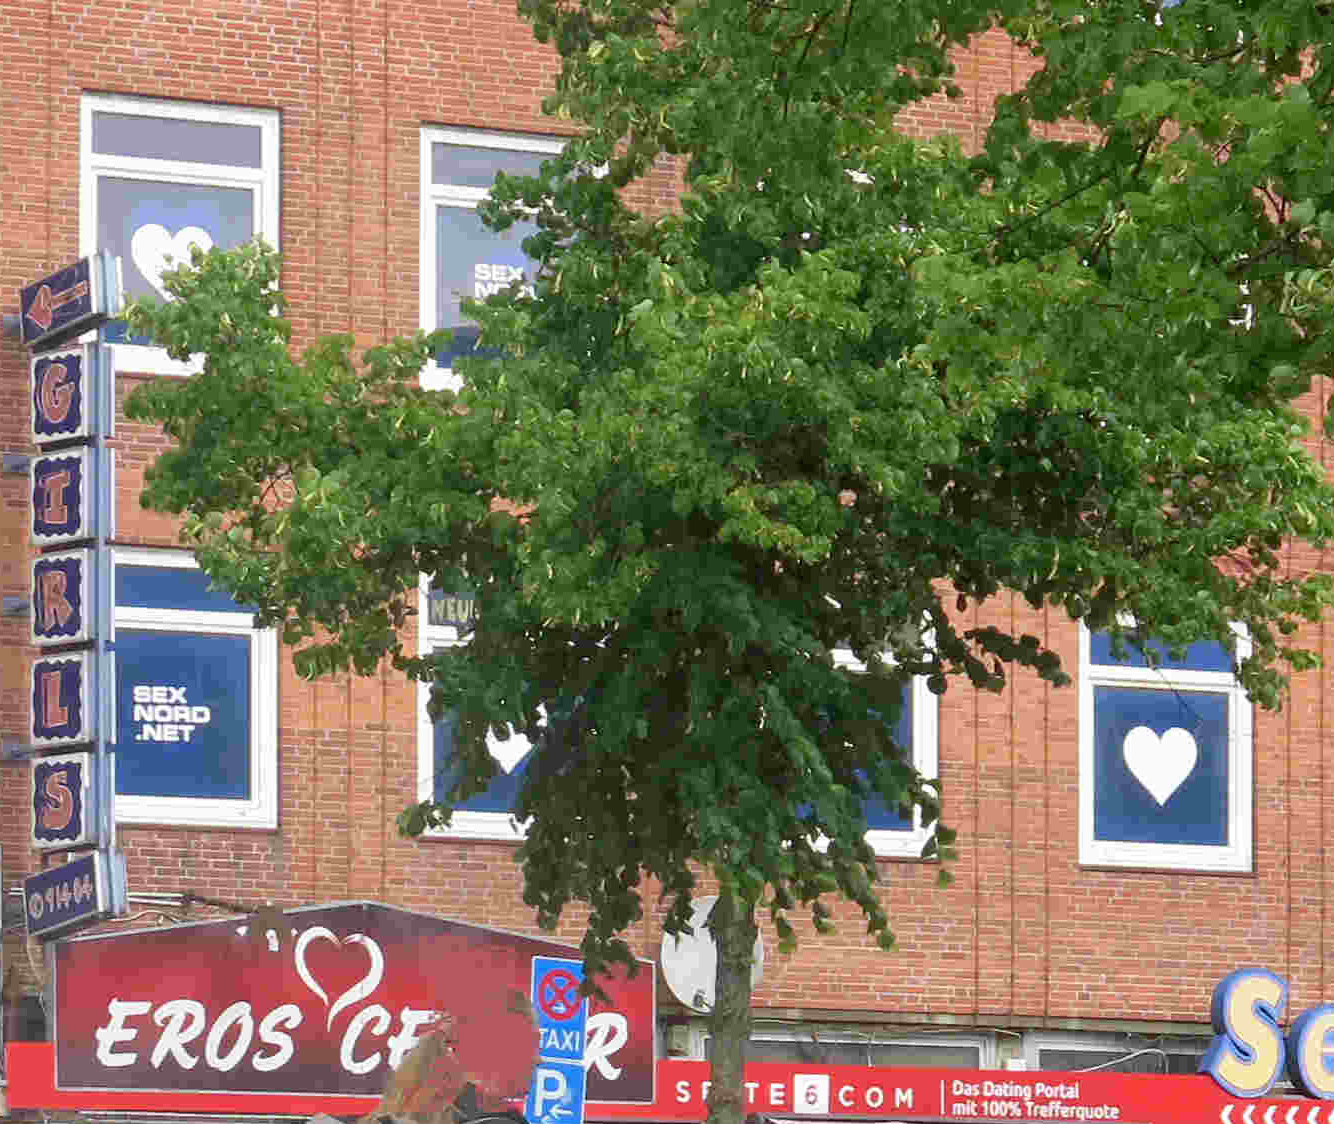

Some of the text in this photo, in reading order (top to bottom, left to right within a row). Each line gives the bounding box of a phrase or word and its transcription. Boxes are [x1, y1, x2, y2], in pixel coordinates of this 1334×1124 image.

[474, 263, 524, 281] SEX
[133, 685, 188, 704] SEX
[133, 703, 211, 724] NORD
[135, 722, 195, 742] .NET
[95, 997, 302, 1073] EROS
[538, 1028, 580, 1052] TAXI
[952, 1080, 1080, 1101] Das Dating Portal
[952, 1100, 1121, 1121] mit 100% Trefferquote
